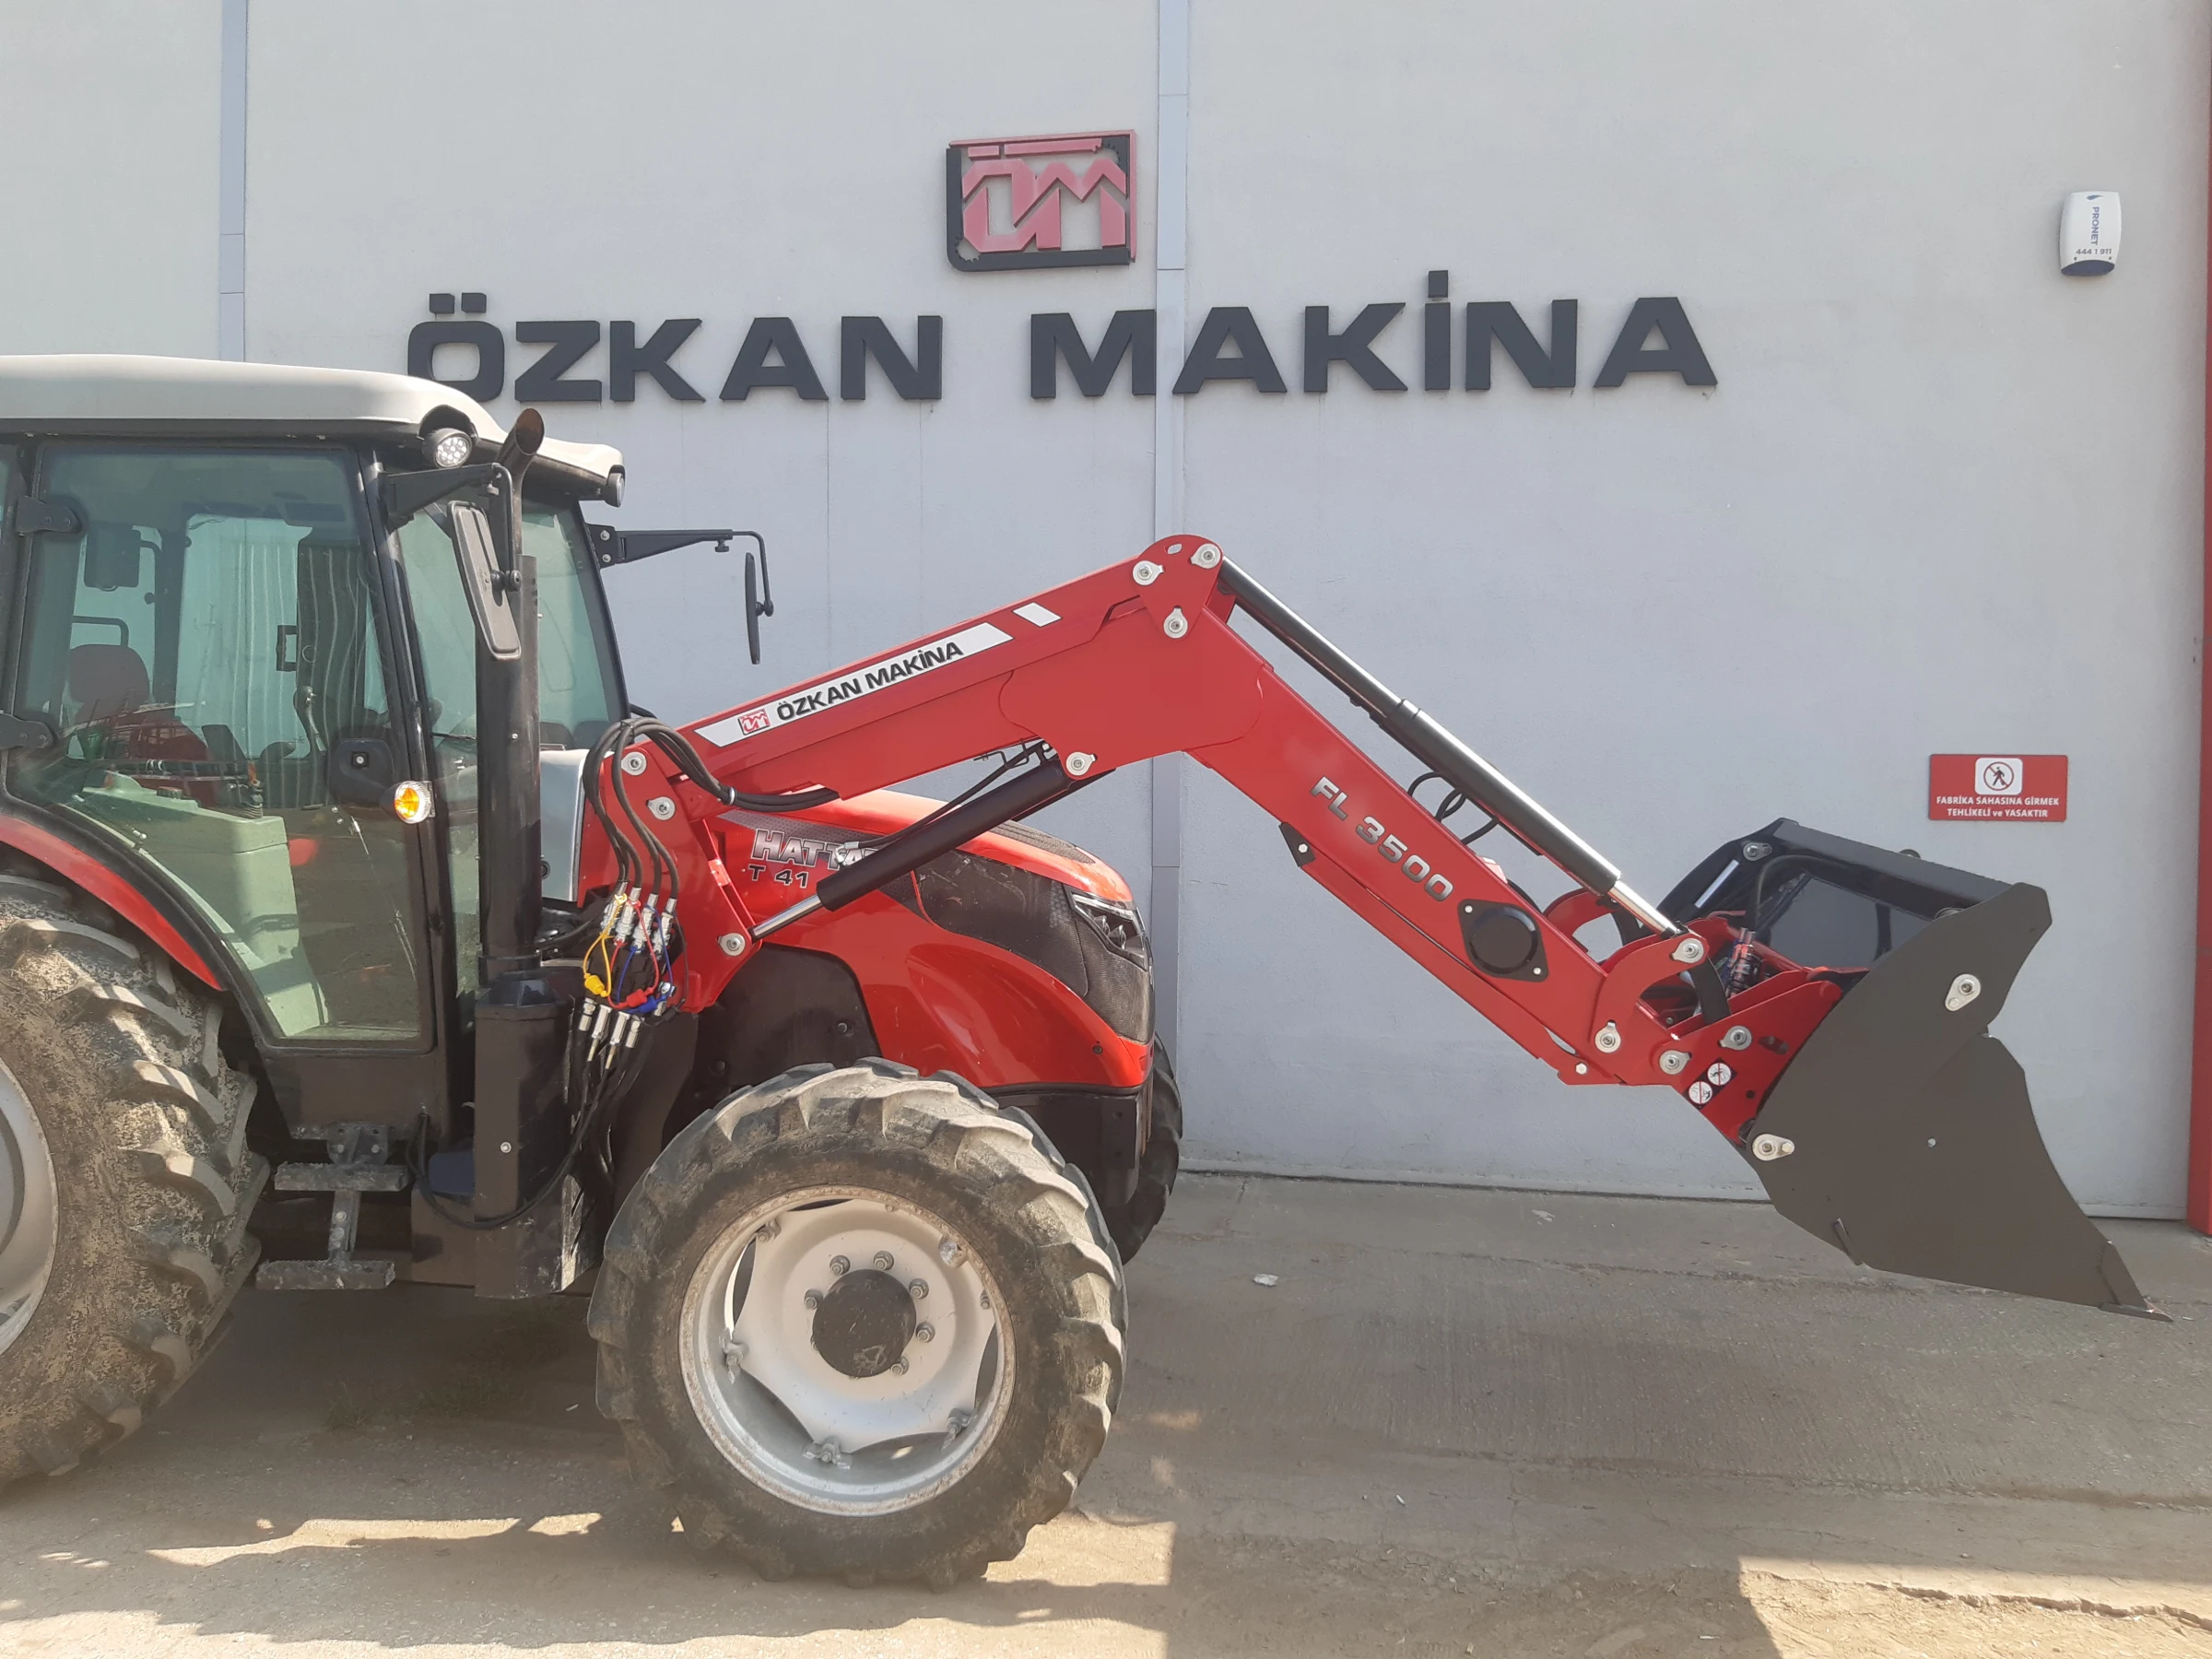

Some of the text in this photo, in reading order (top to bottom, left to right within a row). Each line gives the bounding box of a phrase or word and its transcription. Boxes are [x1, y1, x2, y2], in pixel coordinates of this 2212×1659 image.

[2090, 206, 2100, 245] PRONET
[407, 270, 1718, 404] ÖZKAN MAKİNA
[777, 641, 964, 722] ÖZKAN MAKİNA
[1936, 795, 2059, 806] FABRİKA SAHASINA GİRMEK
[1947, 807, 1991, 817] TEHLİKELİ
[2005, 809, 2048, 818] YASAKTIR
[751, 829, 878, 870] HATTA
[1310, 775, 1454, 902] FL 3500
[748, 865, 808, 888] T 41
